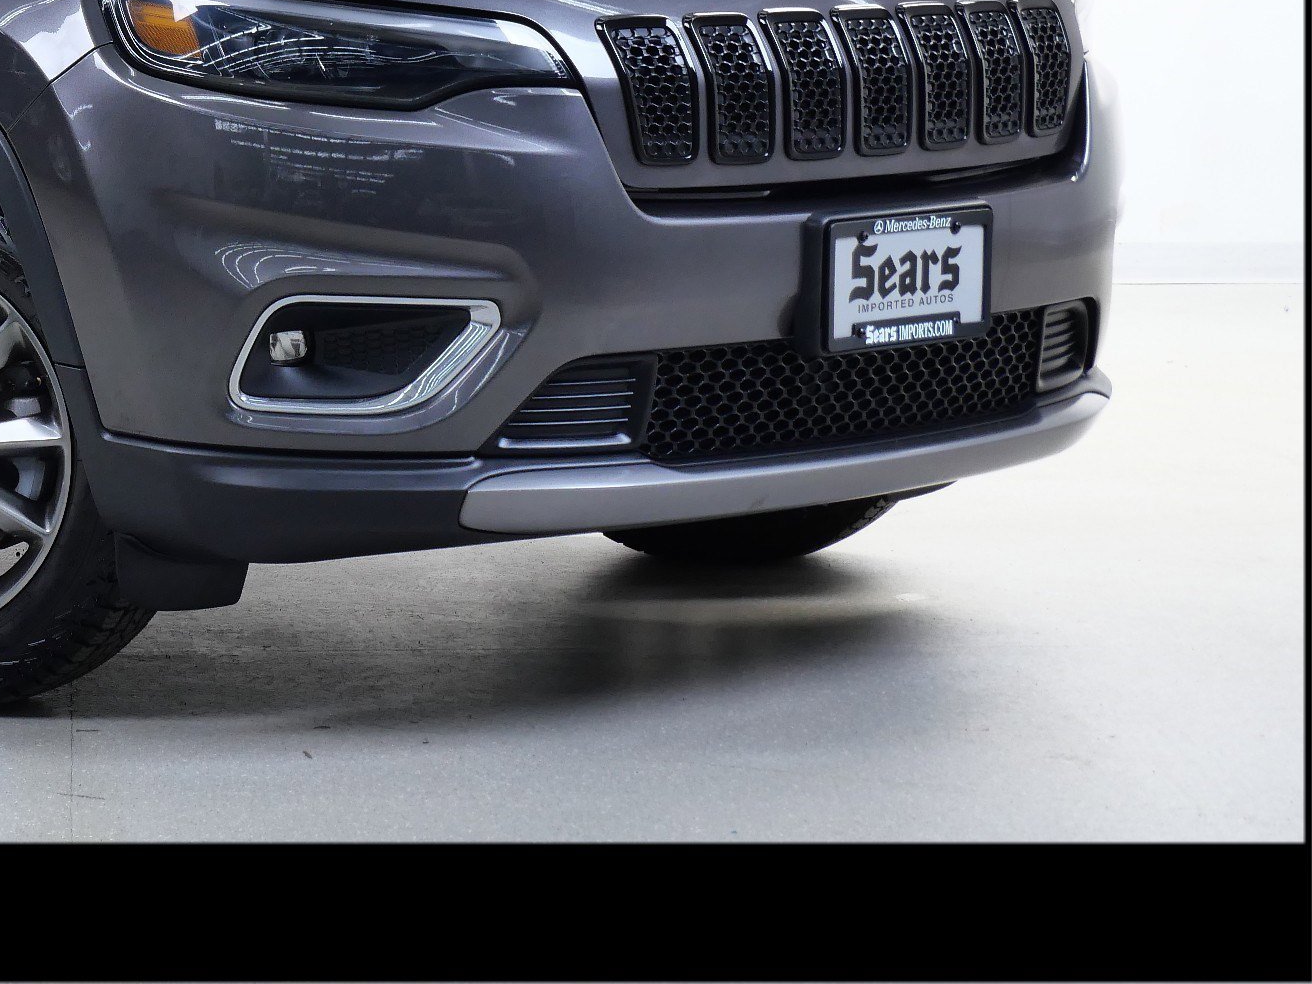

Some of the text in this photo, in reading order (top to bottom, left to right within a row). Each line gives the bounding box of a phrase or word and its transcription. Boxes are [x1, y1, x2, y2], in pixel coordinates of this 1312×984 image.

[884, 215, 952, 234] Mercedes-Benz
[848, 243, 963, 304] Sears
[857, 293, 955, 314] IMPORTED AUTOS
[865, 319, 954, 345] Sears IMPORTS.COM
